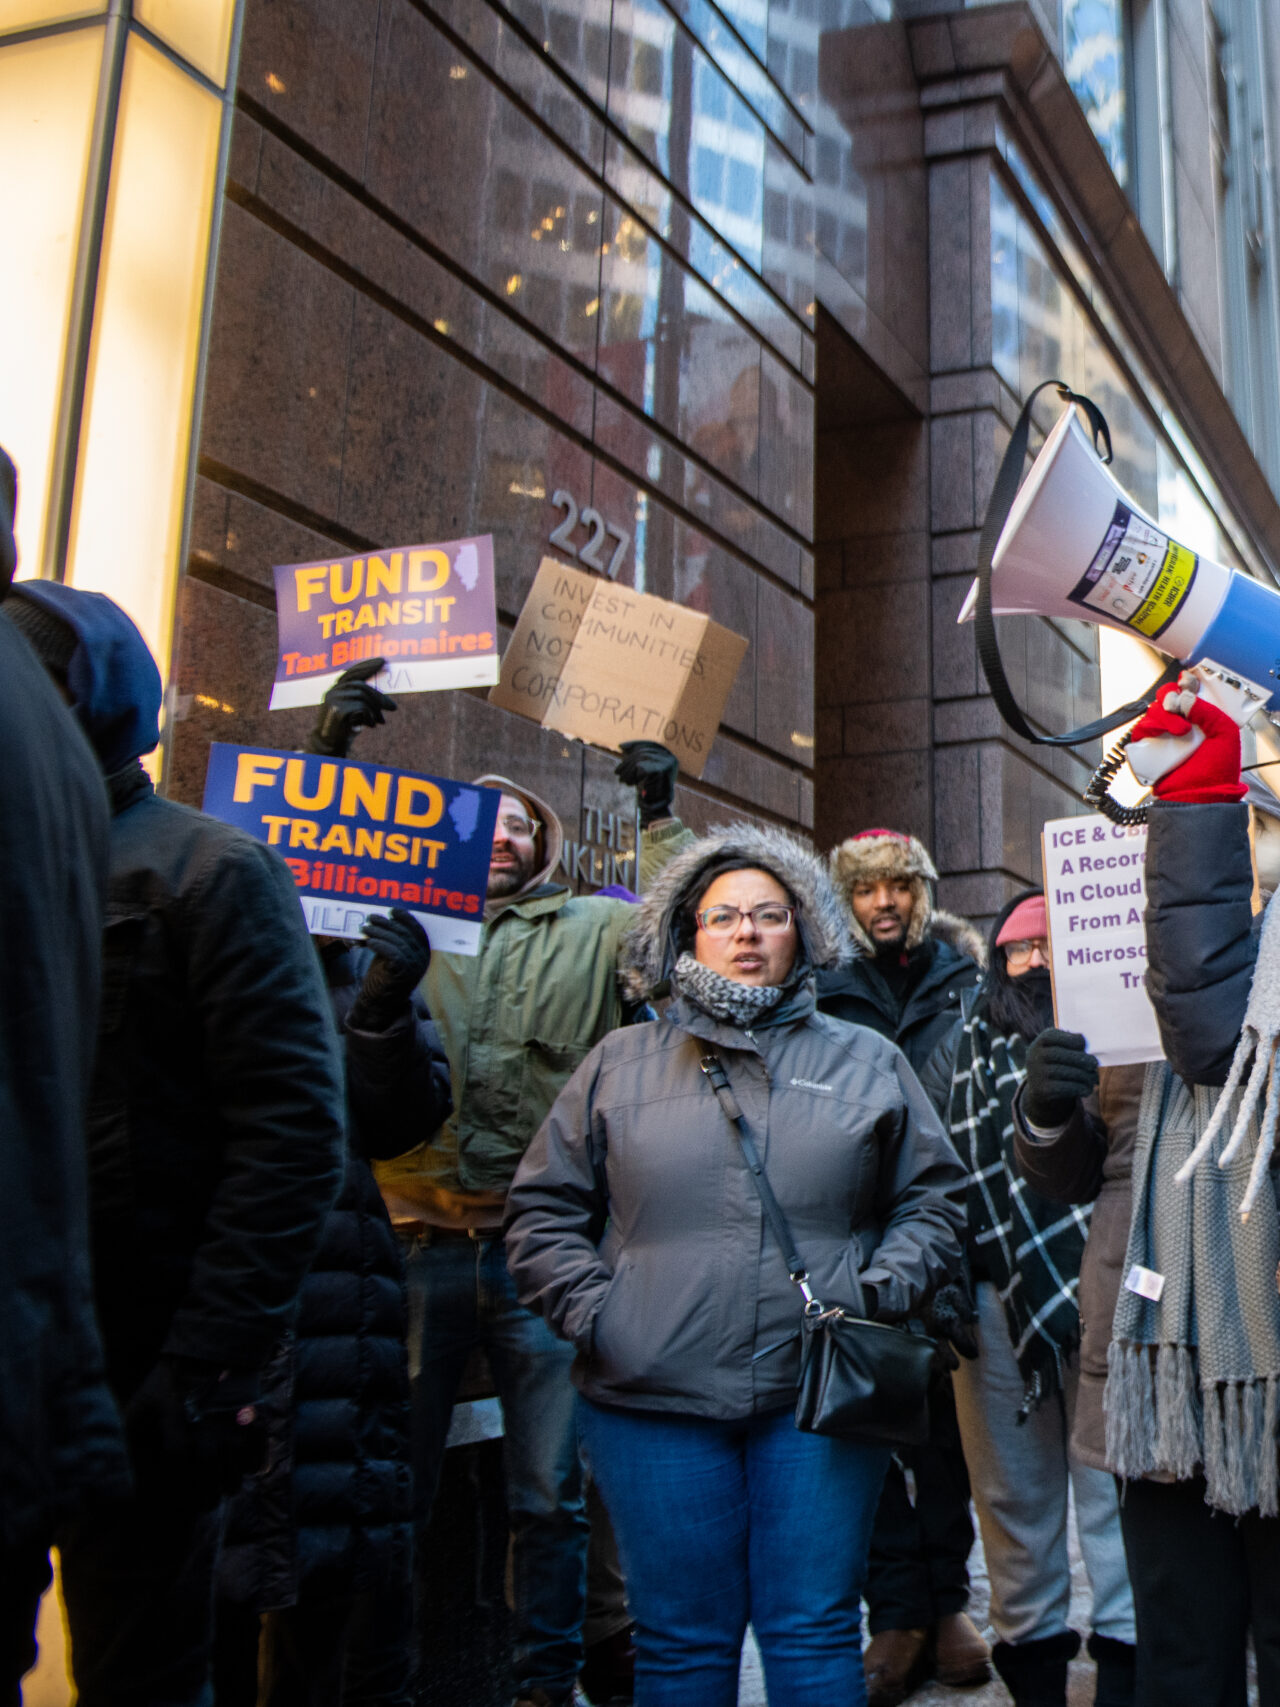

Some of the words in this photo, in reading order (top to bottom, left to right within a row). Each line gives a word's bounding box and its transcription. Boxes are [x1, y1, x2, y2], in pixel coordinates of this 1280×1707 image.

[549, 489, 630, 580] 227
[294, 549, 451, 613] FUND
[1152, 576, 1170, 602] HEALTH
[1163, 585, 1180, 607] ICIRR
[318, 596, 456, 639] TRANSIT
[553, 576, 636, 619] INVEST
[650, 611, 675, 631] IN
[282, 651, 327, 676] Tax
[331, 629, 494, 667] Billionaires
[526, 629, 582, 657] NOT
[510, 666, 704, 753] CORPORATIONS
[232, 752, 445, 829] FUND
[261, 814, 447, 869] TRANSIT
[583, 807, 631, 852] THE
[1052, 828, 1086, 849] ICE
[1092, 826, 1105, 842] &
[283, 857, 480, 914] Billionaires
[1060, 859, 1074, 876] A
[1055, 889, 1075, 905] In
[1080, 878, 1142, 901] Cloud
[1068, 914, 1121, 932] From
[1126, 907, 1145, 925] A
[797, 1079, 833, 1092] Columbia
